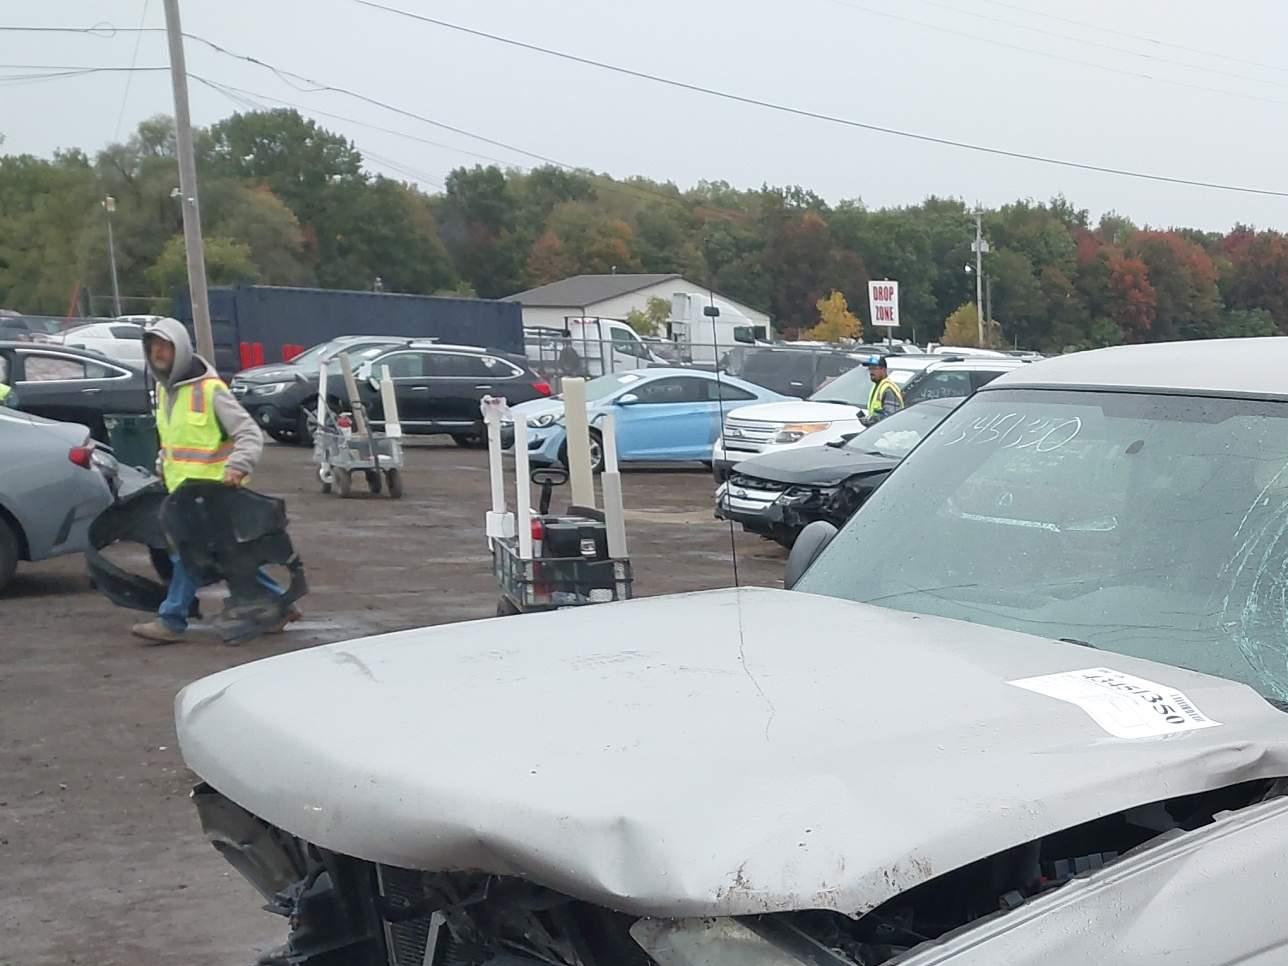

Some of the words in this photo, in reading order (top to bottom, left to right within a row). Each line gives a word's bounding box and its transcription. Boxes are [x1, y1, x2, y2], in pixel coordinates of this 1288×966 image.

[873, 286, 894, 301] DROP
[875, 306, 894, 320] ZONE
[939, 412, 1082, 452] 3451350
[1082, 674, 1185, 724] 43451350
